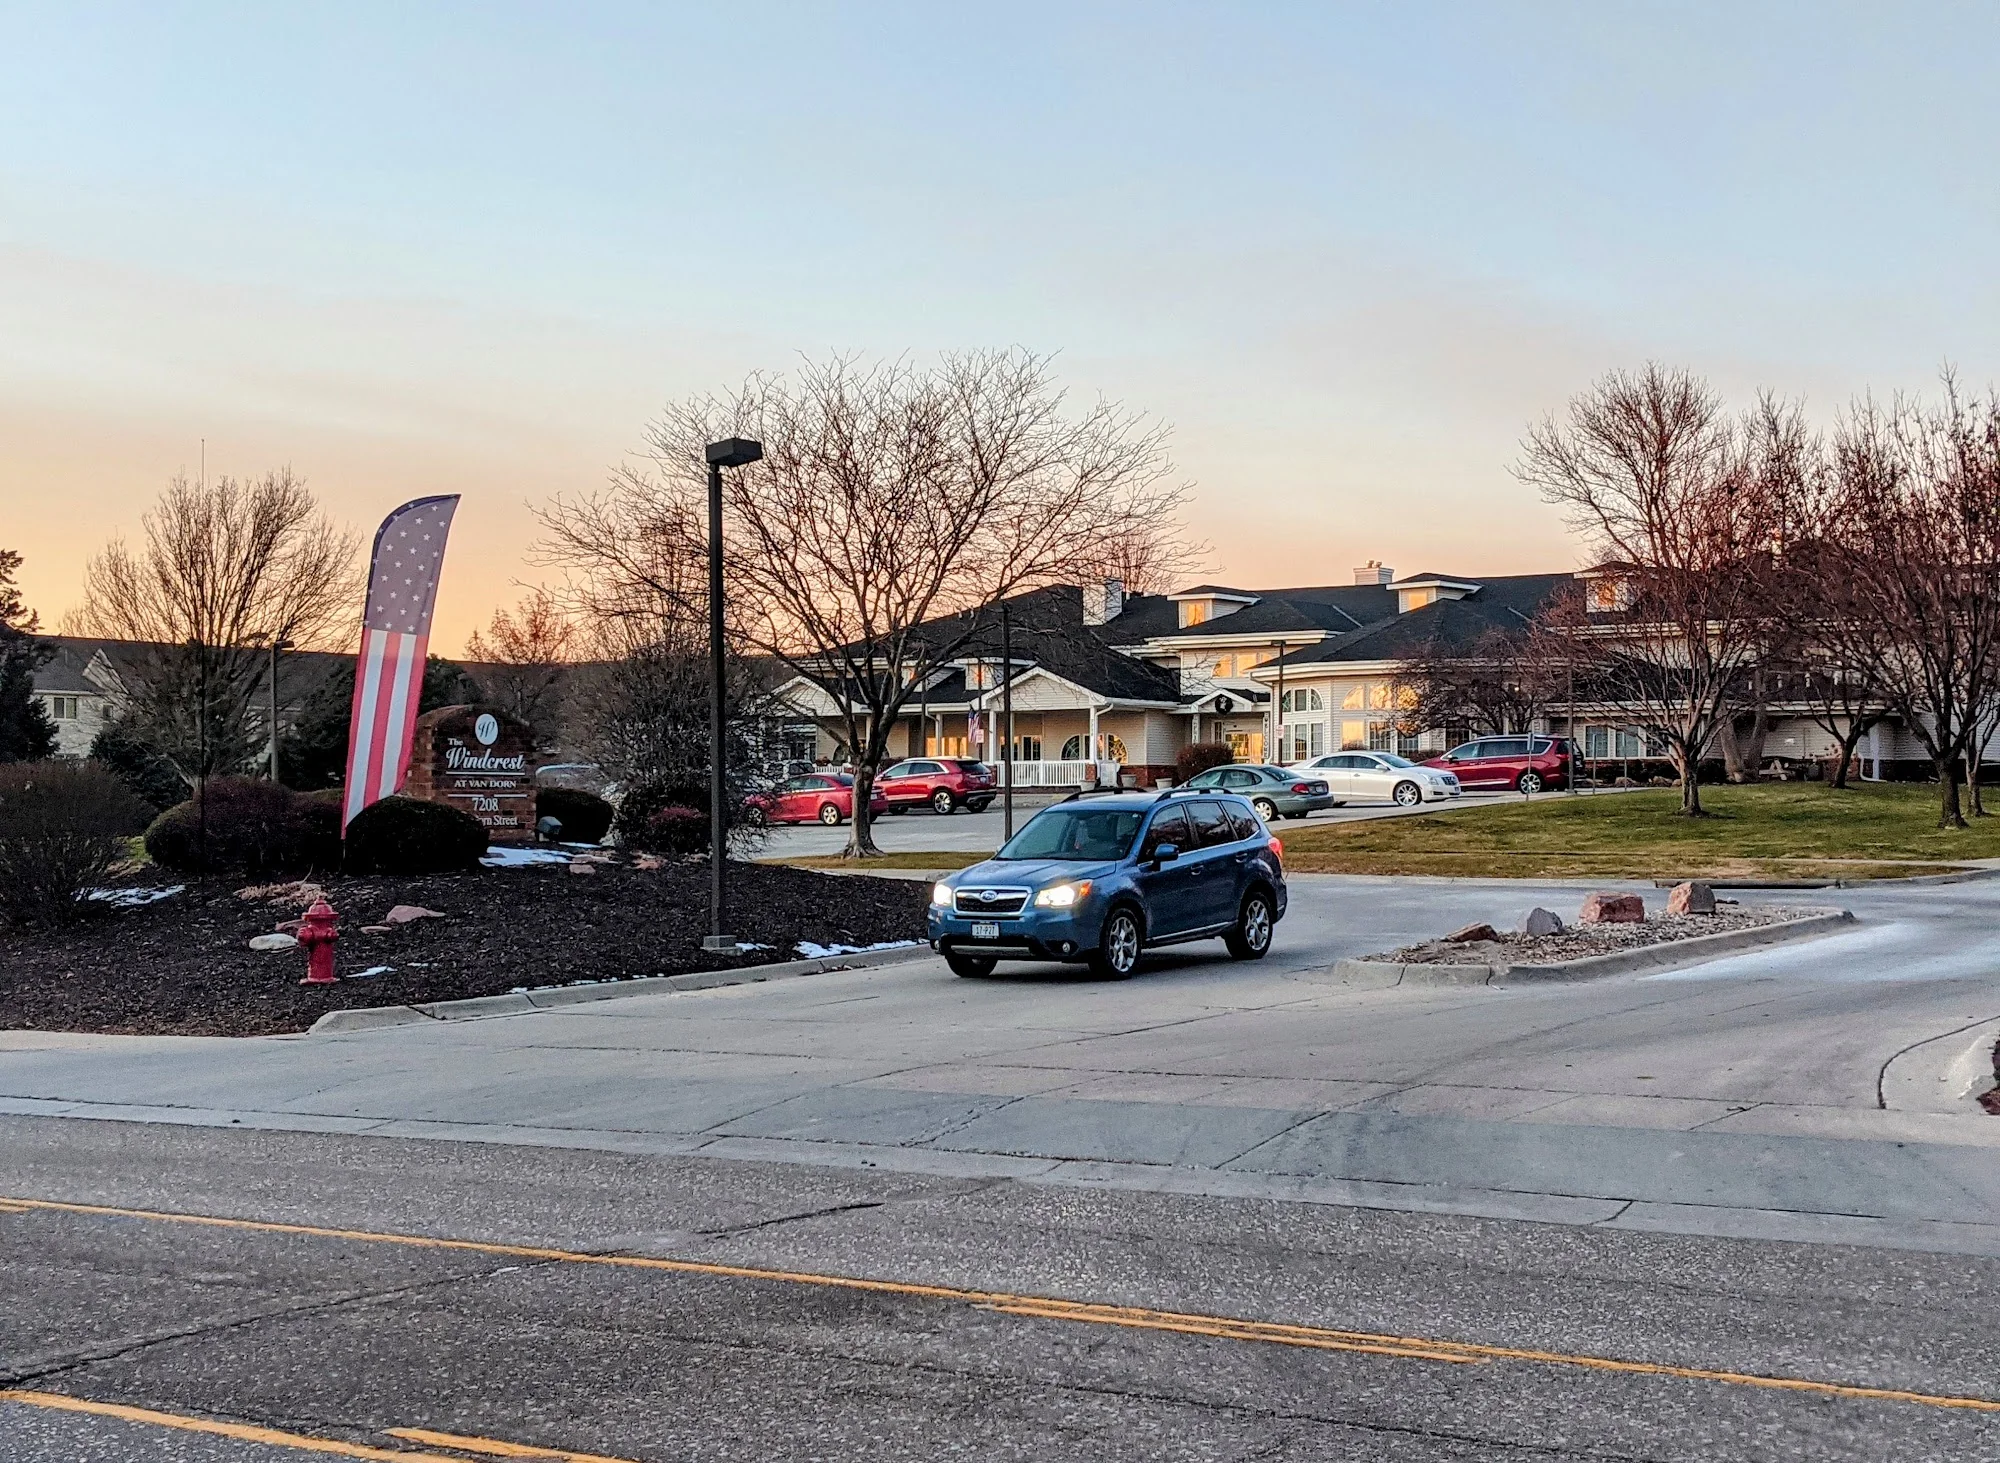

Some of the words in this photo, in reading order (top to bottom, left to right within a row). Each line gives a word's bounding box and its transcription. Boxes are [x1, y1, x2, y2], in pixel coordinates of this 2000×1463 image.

[447, 738, 464, 746] The
[445, 747, 525, 769] Windcrest
[454, 780, 468, 788] AT
[469, 780, 488, 788] VAN
[489, 780, 517, 788] DORN
[472, 798, 499, 811] 7208
[493, 815, 518, 826] Street
